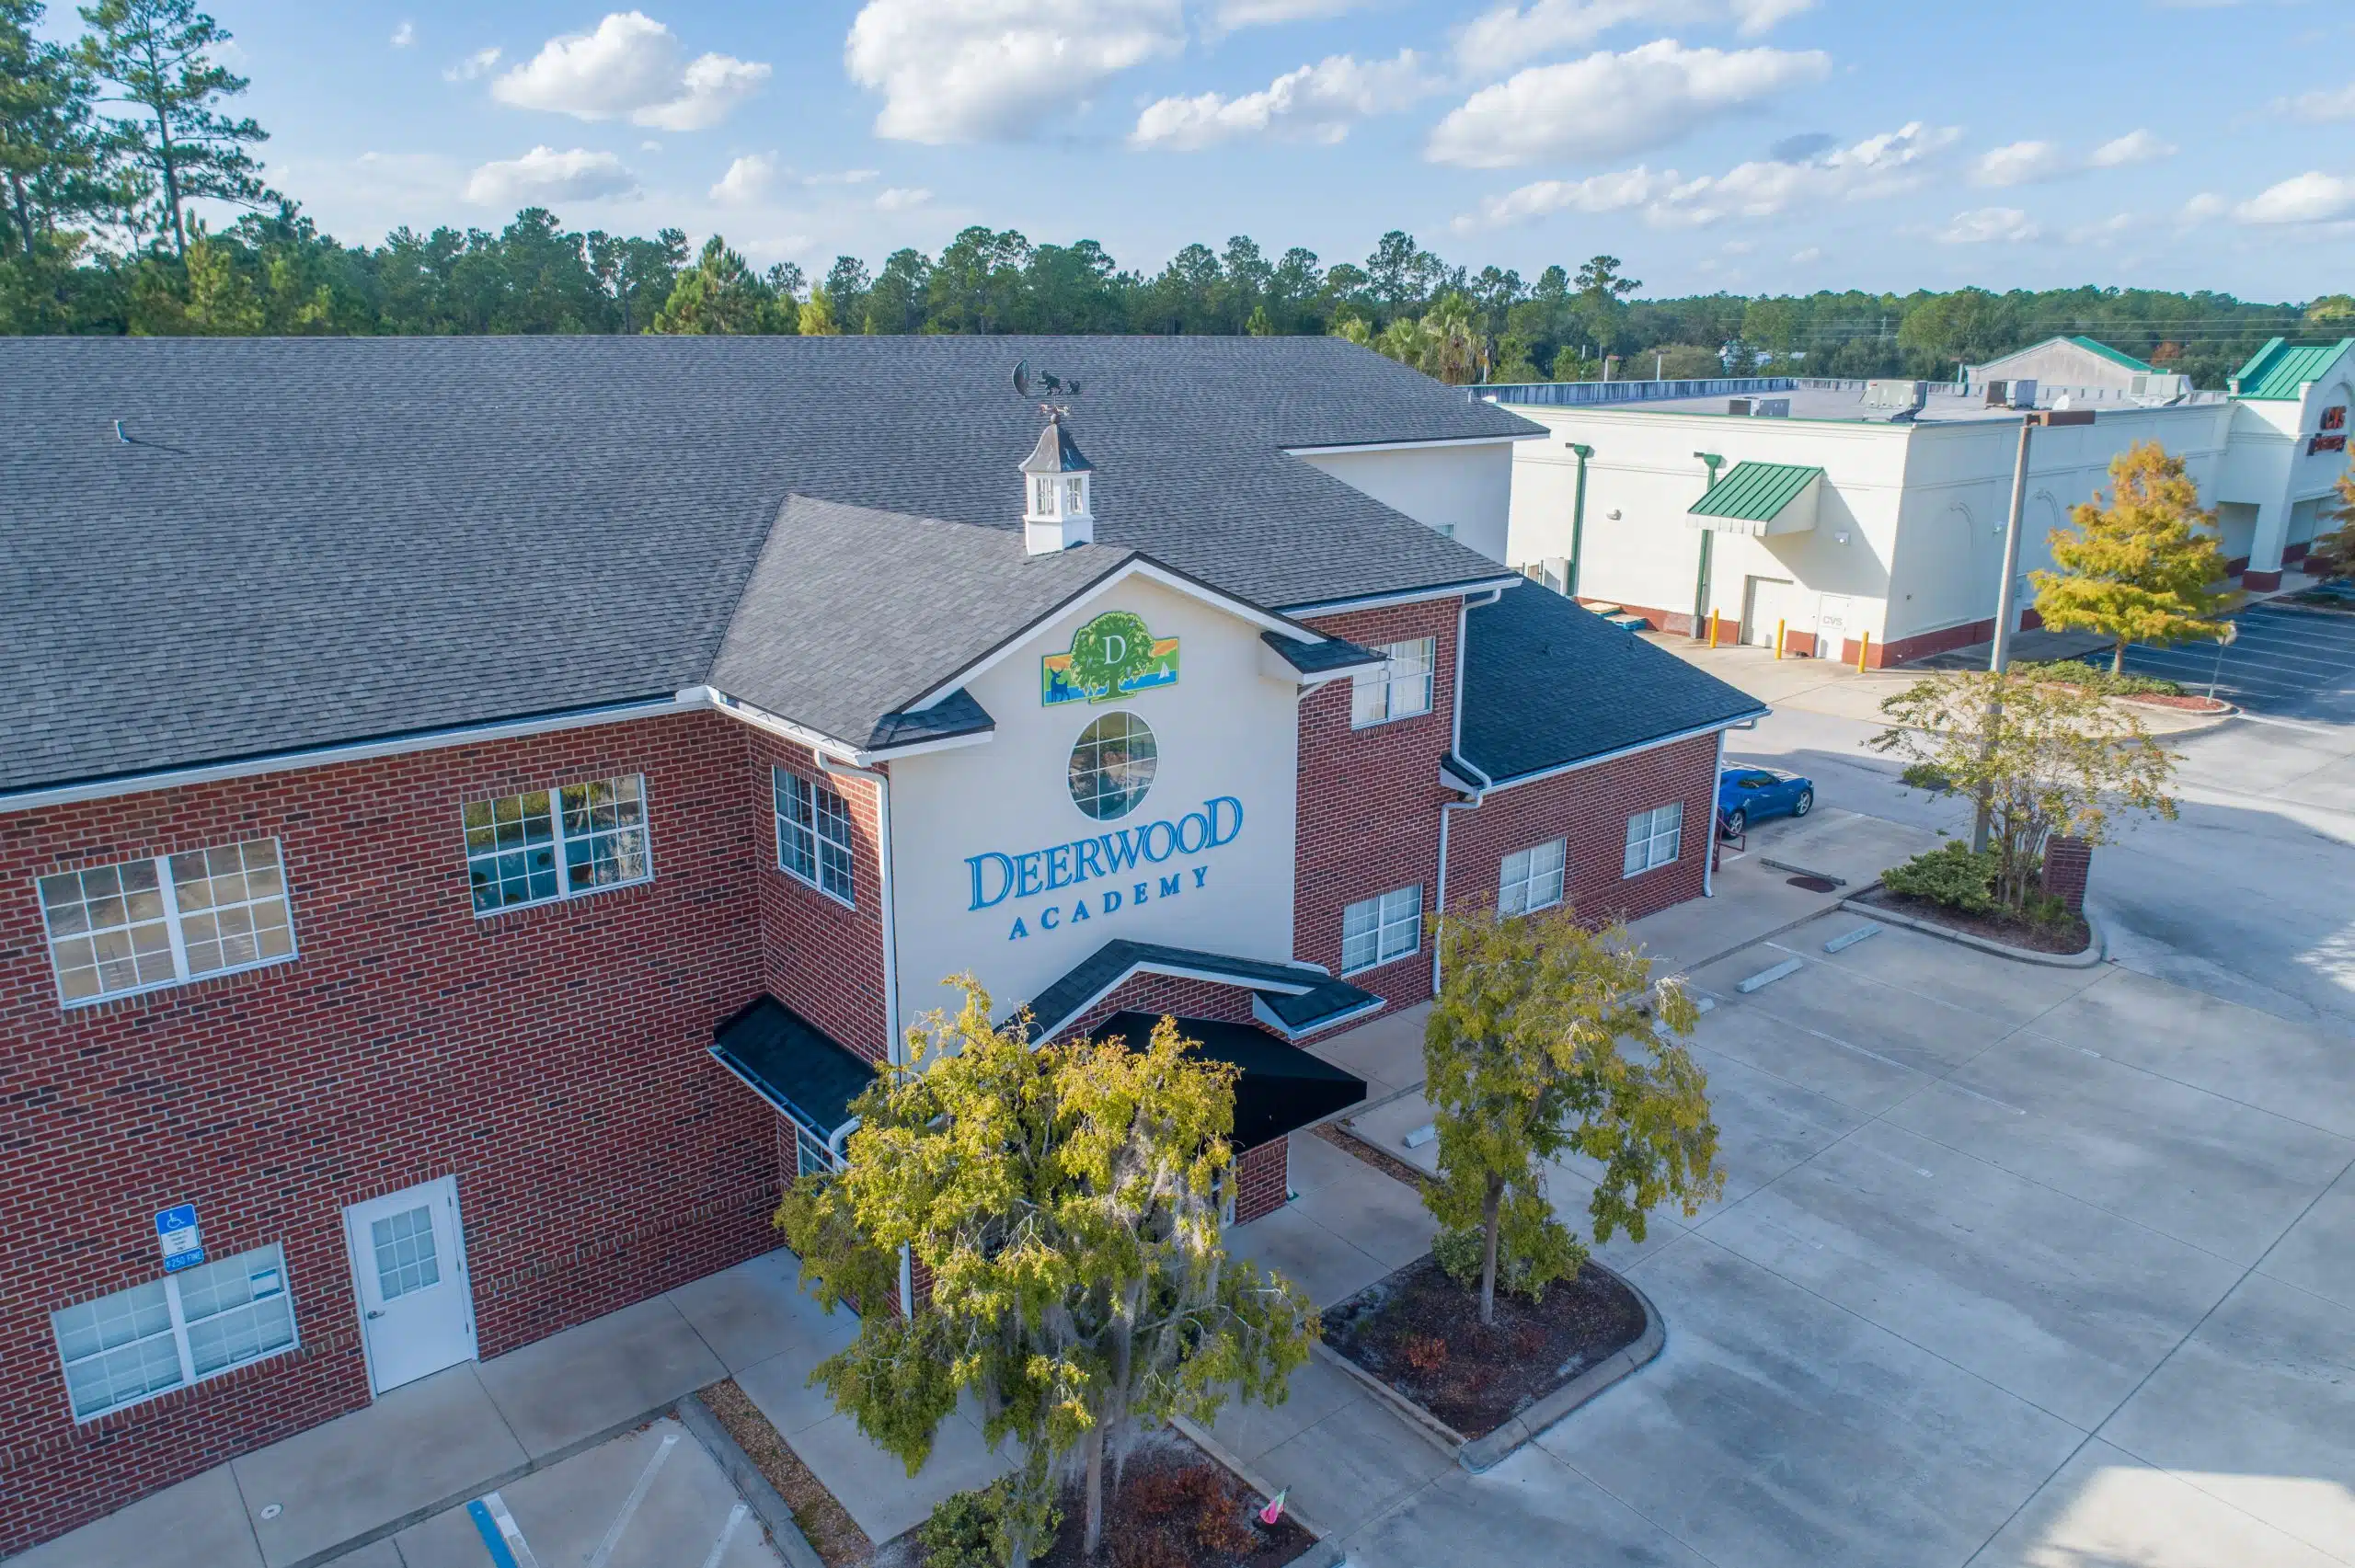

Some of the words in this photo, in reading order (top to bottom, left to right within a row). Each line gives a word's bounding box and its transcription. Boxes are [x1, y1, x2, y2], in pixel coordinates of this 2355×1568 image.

[1822, 615, 1843, 625] CVS
[1104, 635, 1126, 665] D
[964, 795, 1244, 911] DEERWOOD
[1008, 865, 1209, 941] ACADEMY
